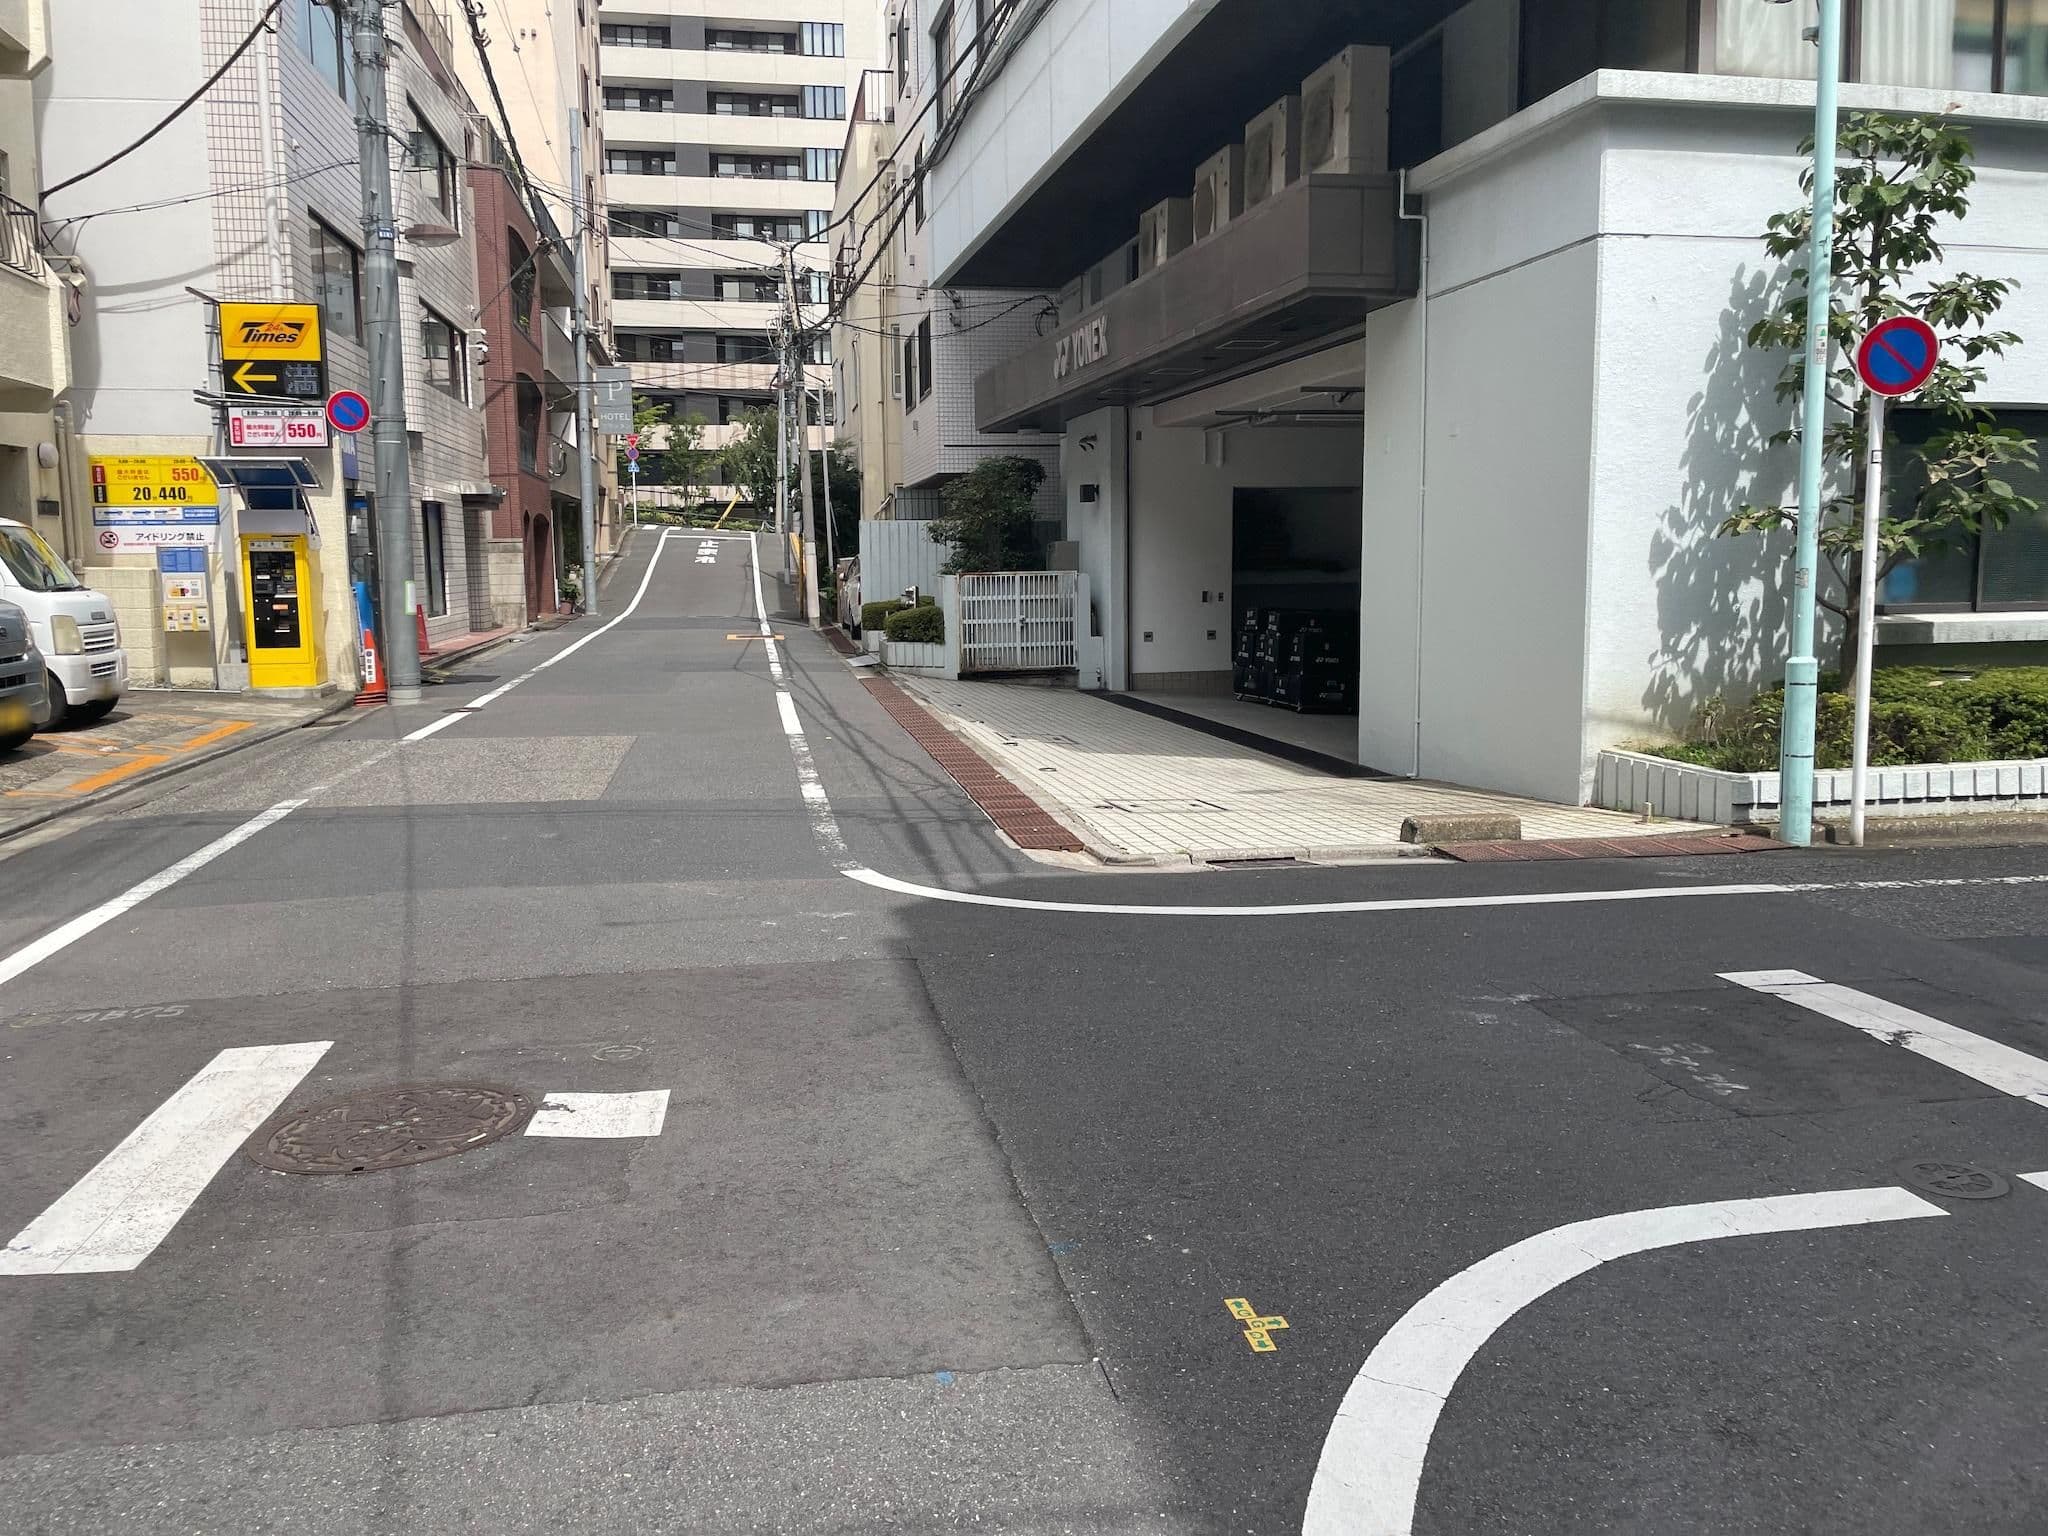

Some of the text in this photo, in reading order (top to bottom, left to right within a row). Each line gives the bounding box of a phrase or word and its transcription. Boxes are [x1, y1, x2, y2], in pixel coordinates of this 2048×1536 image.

[242, 328, 299, 344] Times
[1071, 314, 1109, 371] YONEX
[607, 379, 624, 401] P
[600, 412, 631, 421] HOTEL
[135, 532, 205, 541] アイドリング禁止
